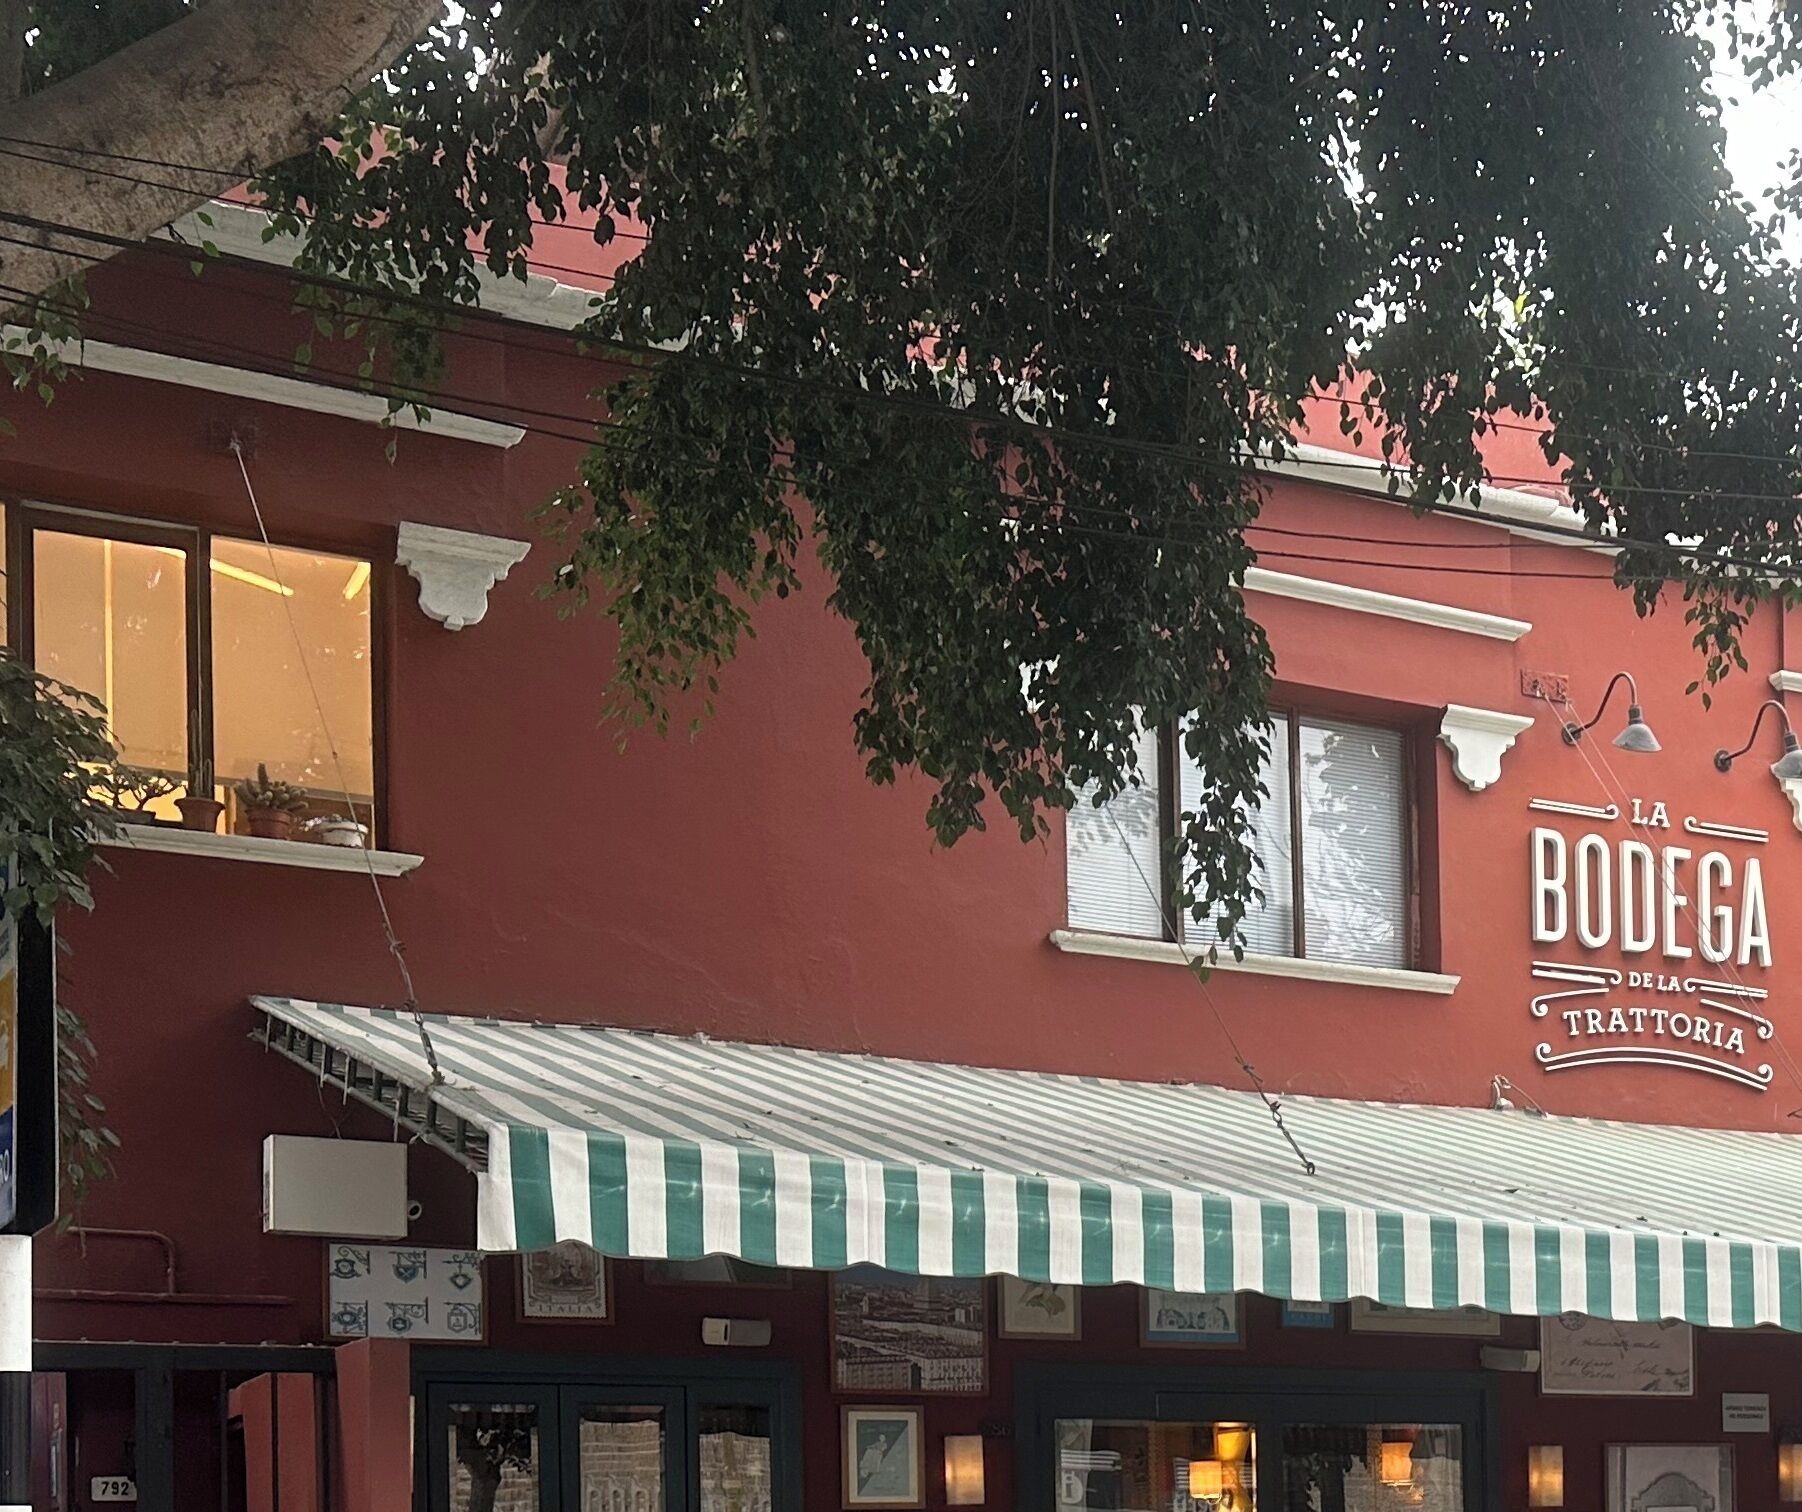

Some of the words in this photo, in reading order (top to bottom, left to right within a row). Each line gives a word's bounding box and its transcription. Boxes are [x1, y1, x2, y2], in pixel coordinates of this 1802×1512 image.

[1631, 797, 1671, 829] LA
[1530, 826, 1773, 968] BODEGA
[1627, 970, 1653, 989] DE
[1657, 974, 1681, 993] LA
[1562, 1006, 1746, 1055] TRATTORIA
[538, 1303, 594, 1314] ITALIA
[101, 1480, 130, 1496] 792
